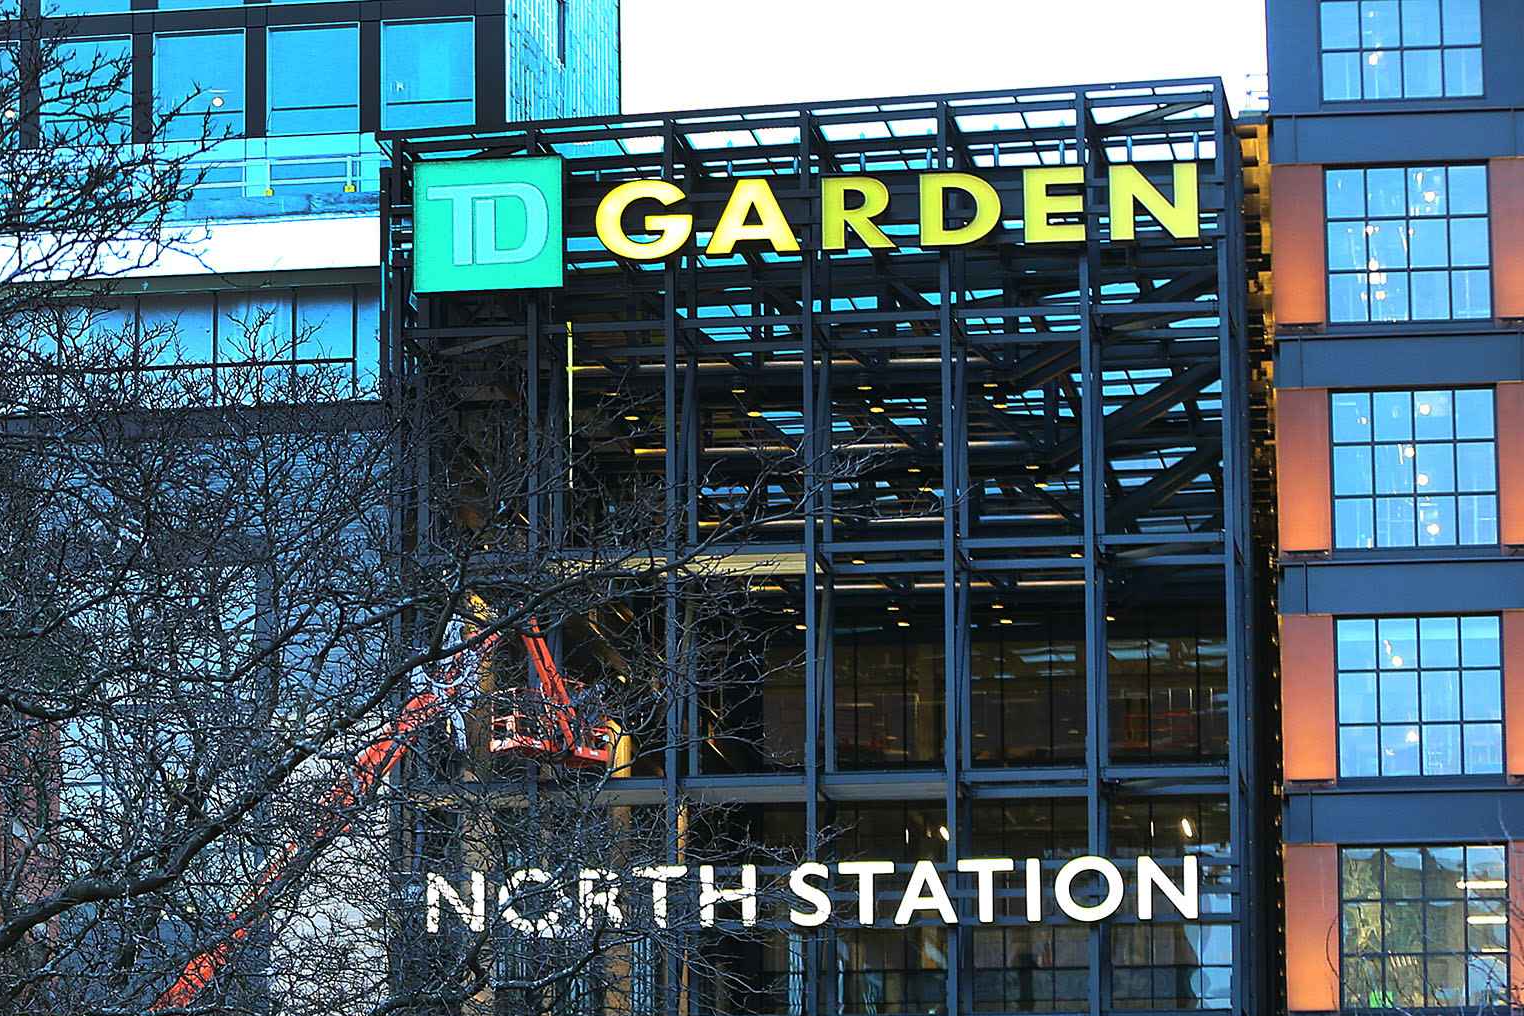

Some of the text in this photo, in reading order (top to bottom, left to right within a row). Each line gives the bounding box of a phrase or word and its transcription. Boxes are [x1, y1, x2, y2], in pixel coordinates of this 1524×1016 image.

[426, 162, 1200, 267] TD GARDEN
[426, 853, 1199, 934] NORTH STATION
